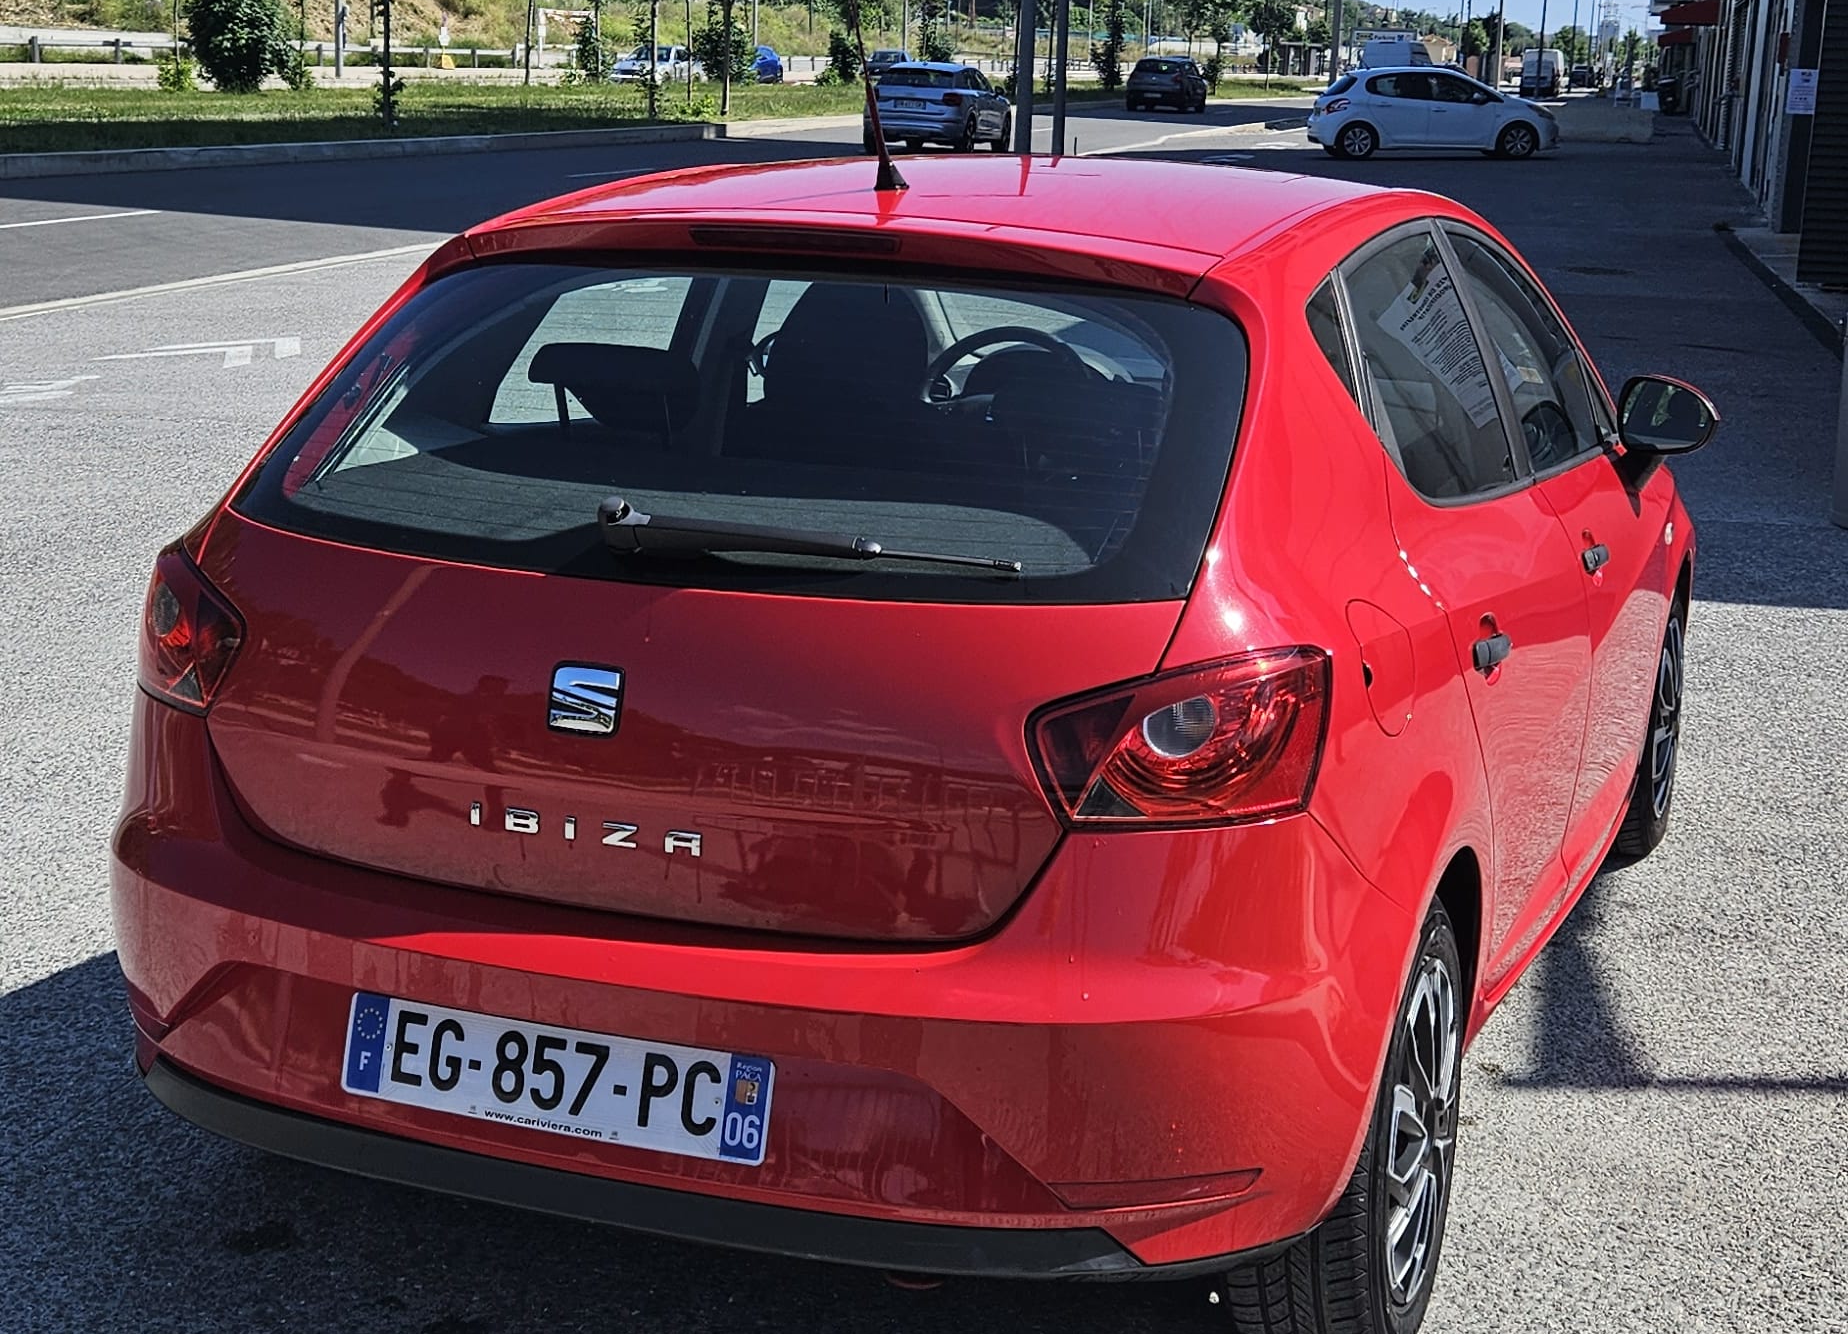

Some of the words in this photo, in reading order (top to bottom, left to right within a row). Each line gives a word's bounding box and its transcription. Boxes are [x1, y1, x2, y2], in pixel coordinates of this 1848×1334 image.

[470, 801, 702, 857] IBIZA
[359, 1051, 371, 1071] F
[391, 1010, 722, 1136] EG-857-PC
[736, 1070, 762, 1082] PACA
[484, 1109, 602, 1138] www.cariviera.com
[724, 1112, 760, 1149] 06
